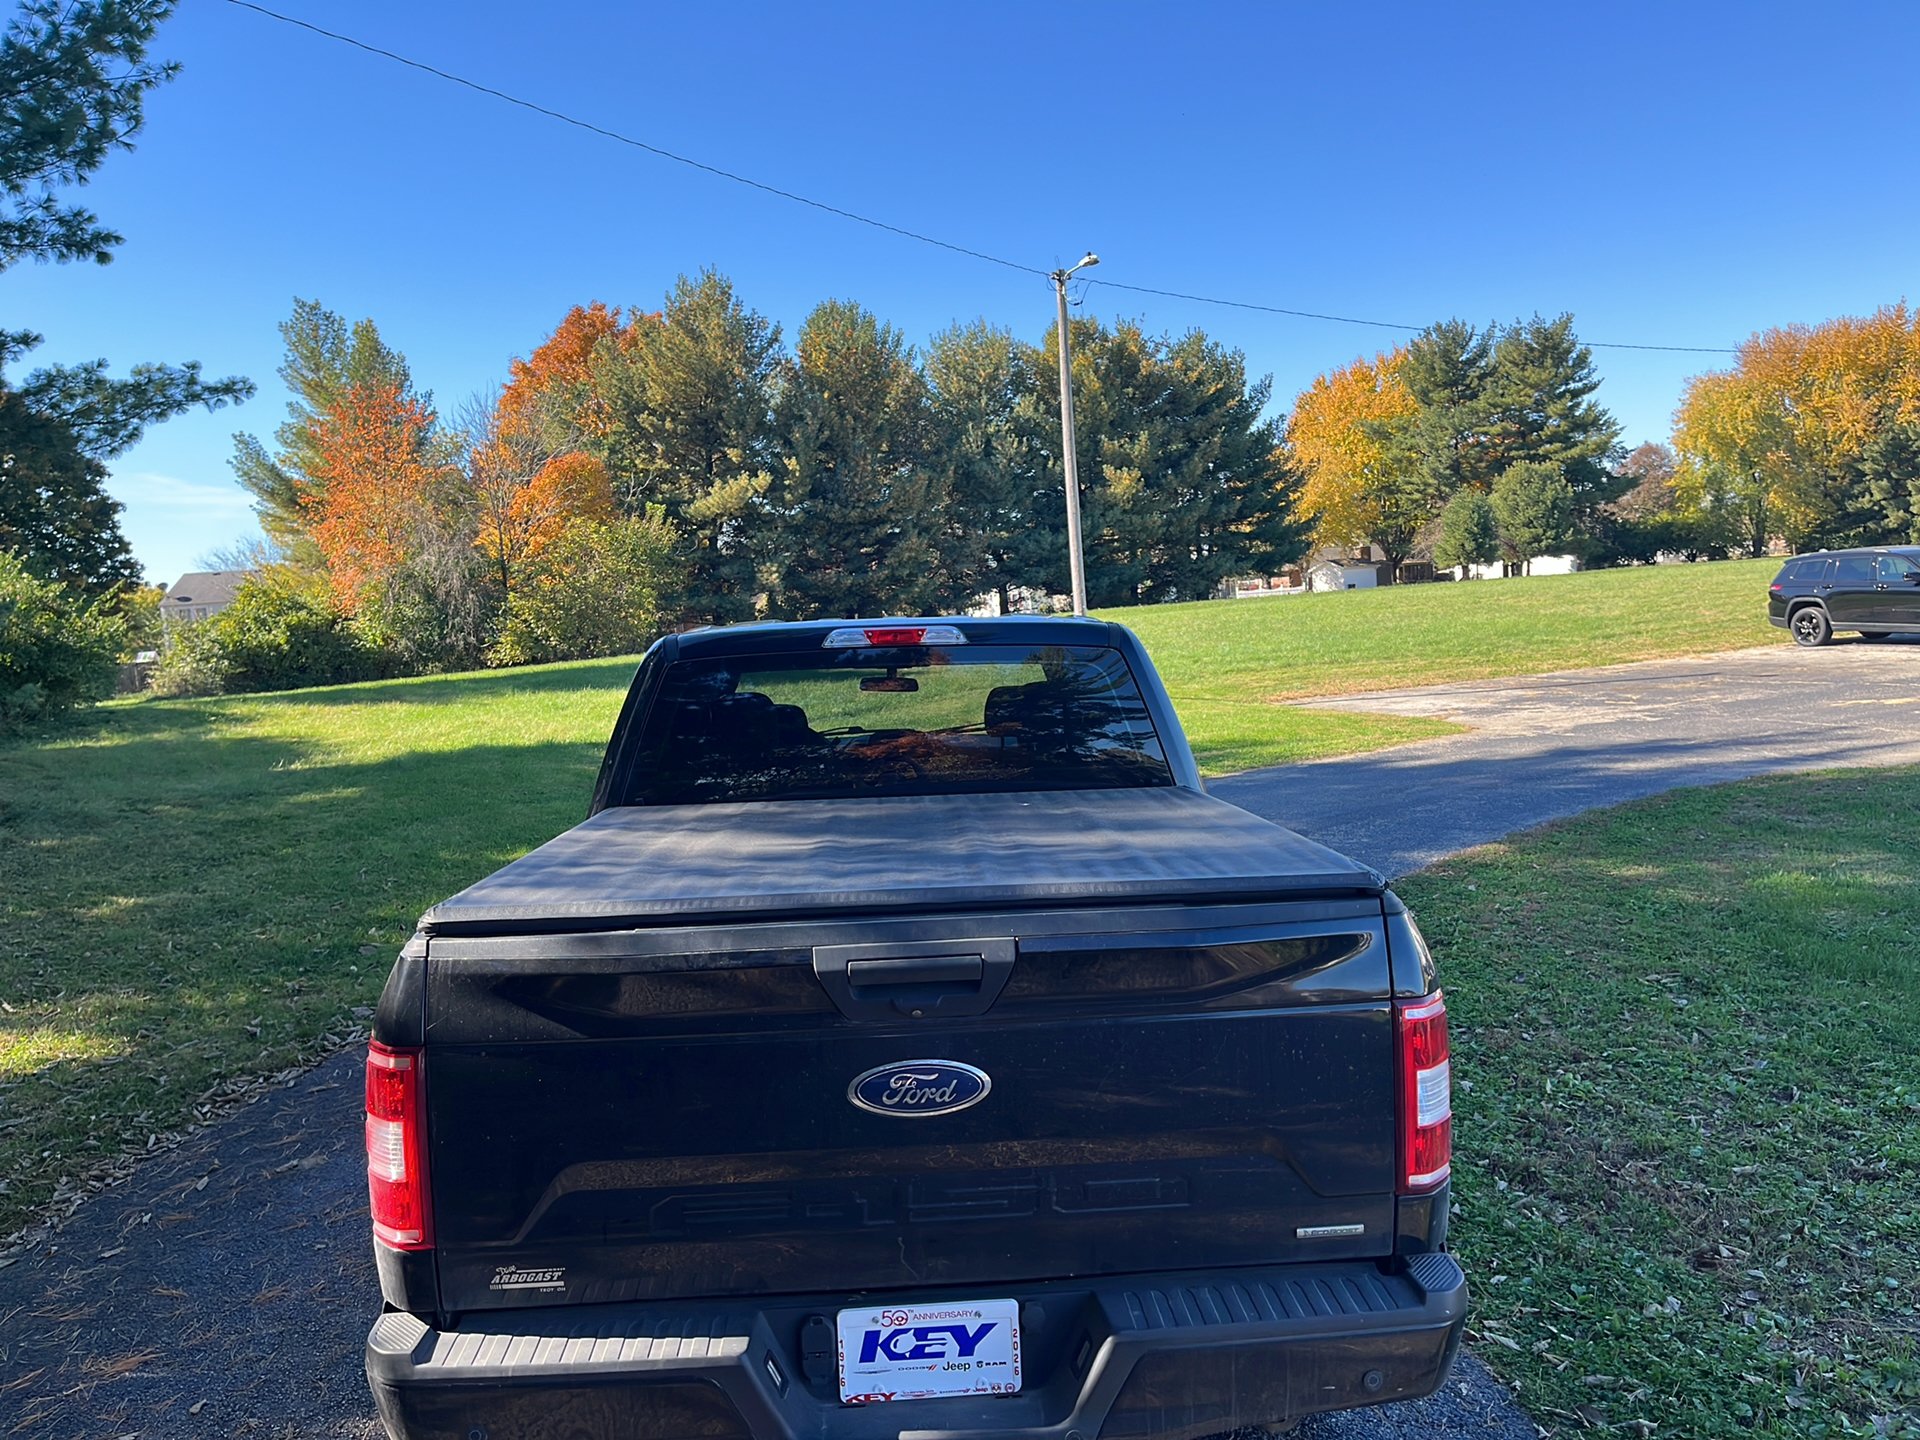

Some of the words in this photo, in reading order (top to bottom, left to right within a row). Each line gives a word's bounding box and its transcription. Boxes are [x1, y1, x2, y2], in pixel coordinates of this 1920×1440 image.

[882, 1073, 958, 1105] Ford
[490, 1272, 562, 1284] ARBOGAST
[913, 1310, 974, 1321] ANNIVERSARY
[858, 1323, 998, 1364] KEY
[1012, 1328, 1020, 1376] 2026
[838, 1339, 846, 1387] 1976
[942, 1361, 971, 1372] Jeep
